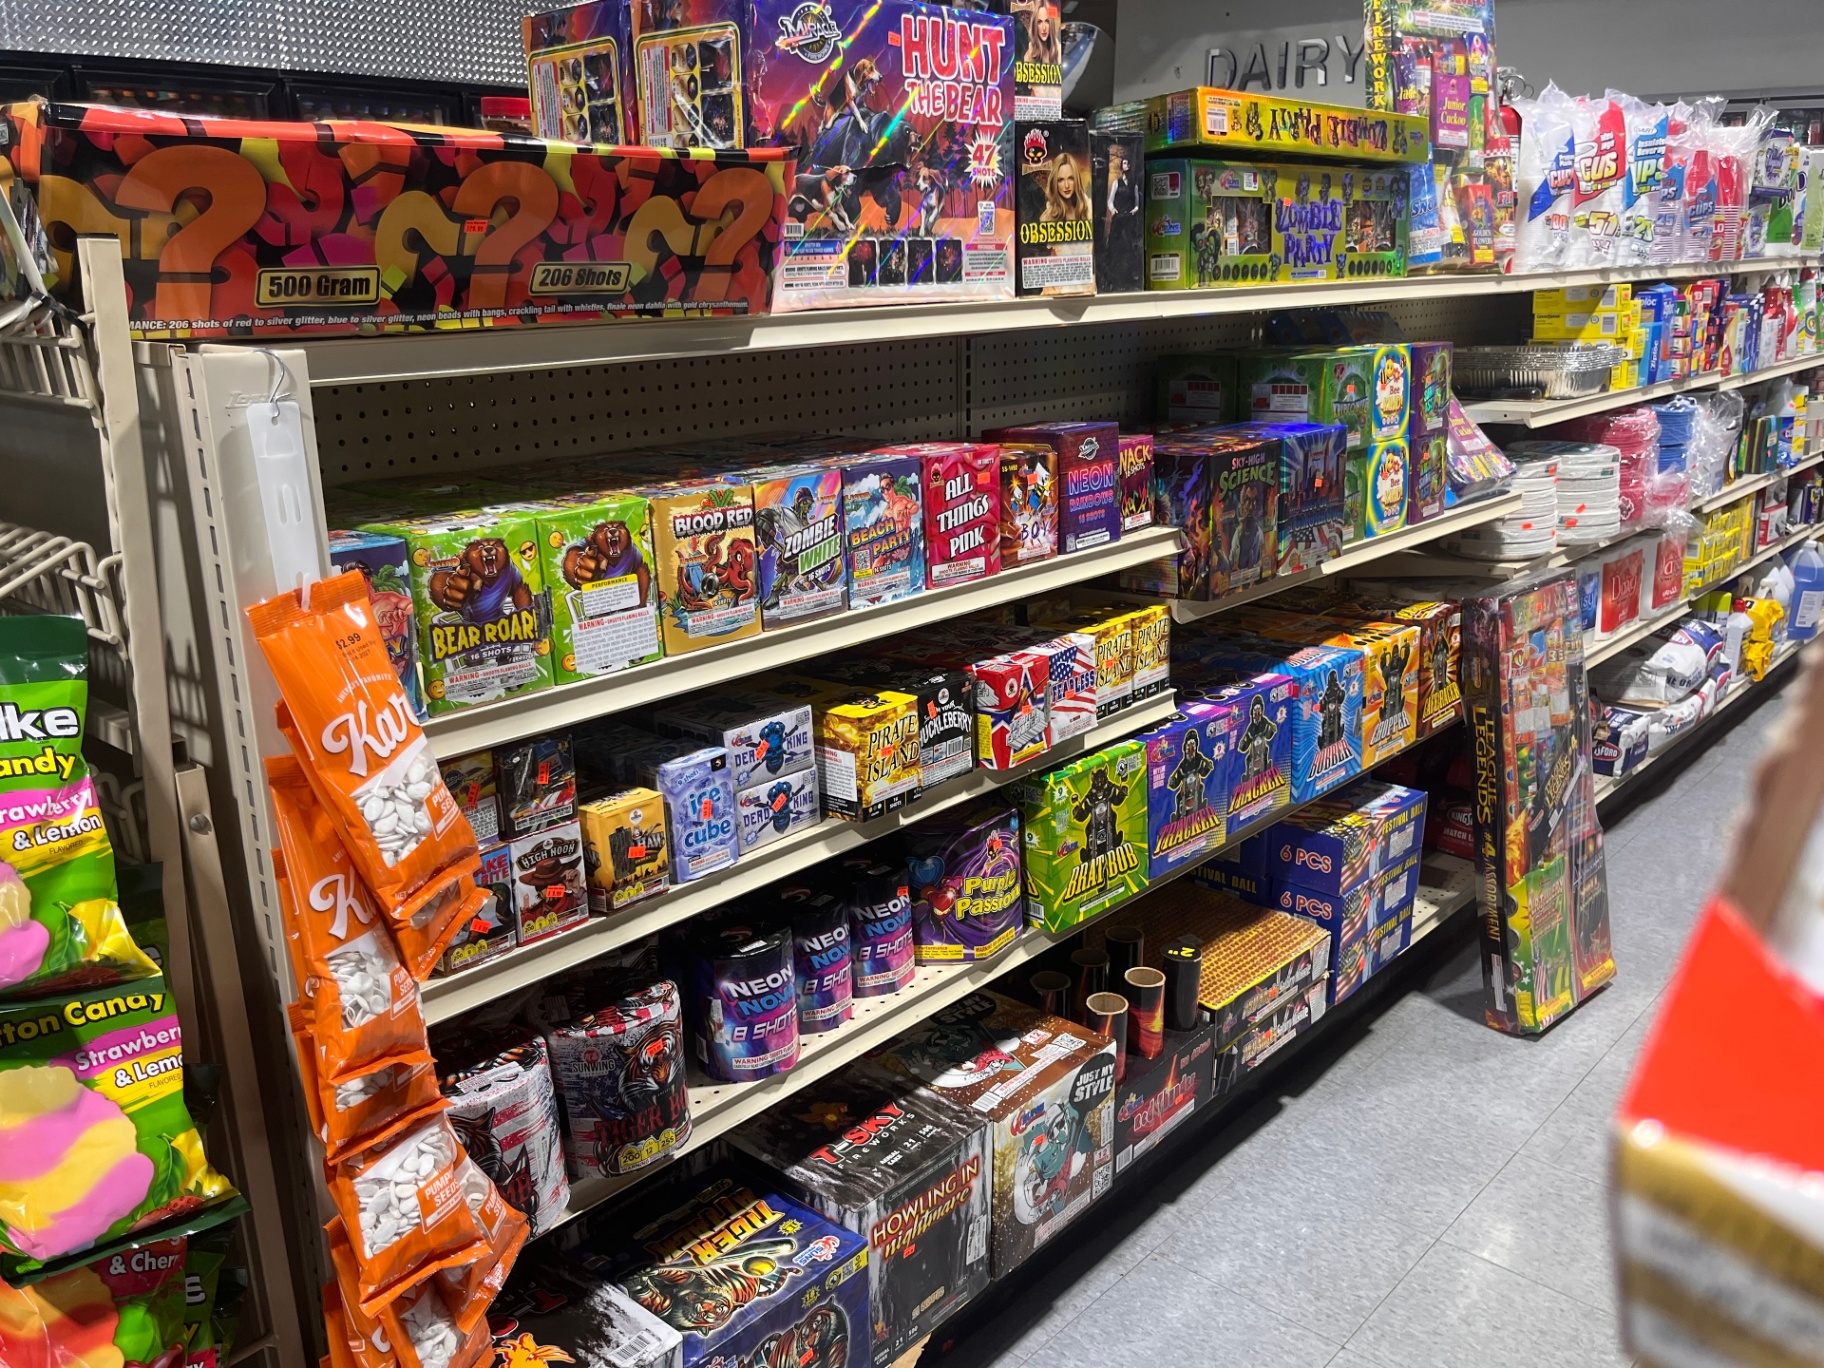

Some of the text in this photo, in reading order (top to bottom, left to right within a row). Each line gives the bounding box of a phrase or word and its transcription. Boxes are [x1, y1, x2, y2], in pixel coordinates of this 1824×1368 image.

[783, 19, 838, 38] MIRACLE
[902, 14, 1005, 84] HUNT
[1371, 0, 1387, 111] FIREWORK
[1015, 61, 1062, 85] BSESSION
[1207, 35, 1364, 91] DAIRY
[905, 79, 1003, 125] THE BEAR
[1443, 97, 1466, 112] Junior
[1441, 111, 1467, 125] Cuckoo
[972, 143, 996, 167] 47
[972, 167, 996, 178] SHOTS
[1275, 199, 1343, 234] ZOMBIE
[1689, 202, 1713, 218] CUPS
[1021, 220, 1093, 245] OBSESSION
[1023, 257, 1047, 266] WARNING
[1283, 233, 1336, 268] PARTY
[269, 275, 371, 298] 500 Gram
[538, 267, 622, 288] 206 Shots
[169, 319, 189, 330] 206
[191, 318, 221, 329] shots
[222, 318, 234, 328] of
[235, 318, 252, 327] red
[254, 317, 265, 327] to
[266, 316, 293, 327] silver
[295, 315, 326, 327] glitter,
[328, 315, 348, 325] blue
[350, 315, 360, 324] to
[361, 313, 387, 324] silver
[388, 313, 415, 324] glitter,
[417, 312, 436, 322] neon
[438, 309, 462, 320] beads
[463, 309, 480, 318] with
[482, 307, 508, 319] bangs,
[509, 305, 543, 316] crackling
[544, 305, 556, 313] tail
[558, 304, 573, 313] with
[607, 302, 626, 310] finale
[1650, 340, 1659, 370] Ziploc
[1389, 386, 1401, 394] Bee
[1231, 452, 1266, 471] SKY-HIGH
[945, 473, 973, 502] ALL
[1068, 463, 1114, 496] NEON
[1218, 461, 1277, 502] SCIENCE
[1390, 479, 1401, 488] Bee
[937, 495, 990, 533] THINGS
[1069, 490, 1115, 512] RAINBOWS
[675, 507, 753, 537] BLOOD RED
[850, 517, 896, 547] BEACH
[784, 515, 836, 559] ZOMBIE
[873, 530, 911, 557] PARTY
[950, 525, 985, 559] PINK
[799, 534, 841, 574] WHITE
[947, 561, 970, 569] WARNING
[592, 577, 628, 589] PERFORMANCE
[784, 597, 804, 606] WARNING
[578, 618, 605, 631] WARNING
[692, 615, 714, 624] WARNING
[335, 632, 361, 650] $2.99
[432, 608, 539, 660] BEAR ROAR!
[1137, 617, 1170, 651] PIRATE
[471, 646, 512, 661] 16 SHOTS
[1096, 632, 1131, 667] PIRATE
[1134, 639, 1170, 672] ISLAND
[361, 673, 393, 684] FAVORITE
[449, 672, 480, 684] WARNING
[1052, 670, 1096, 703] FEARLESS
[942, 700, 955, 712] YOUR
[786, 731, 808, 750] KING
[866, 714, 917, 760] PIRATE
[1370, 711, 1411, 746] CHOPPER
[866, 741, 920, 784] ISLAND
[1307, 739, 1354, 781] BOBBER
[1472, 706, 1491, 825] LEGENDS
[1485, 719, 1497, 804] LEAGUE
[682, 769, 699, 784] shots
[689, 786, 721, 815] ice
[793, 790, 814, 810] KING
[1227, 766, 1287, 816] TRACKER
[742, 807, 770, 829] DEAD
[1153, 805, 1221, 858] TRACKER
[1381, 807, 1409, 835] FESTIVAL
[1410, 801, 1423, 819] BALL
[13, 815, 103, 851] & Lemon
[685, 818, 731, 849] cube
[1443, 827, 1464, 840] MATCH
[48, 840, 84, 855] FLAVORED
[522, 842, 576, 869] HIGH NOON
[1280, 844, 1332, 874] 6 PCS
[481, 867, 510, 885] BITE
[1064, 844, 1139, 901] BRAT BOB
[1404, 854, 1418, 872] BALL
[964, 869, 1017, 896] Purple
[1231, 876, 1257, 894] BALL
[855, 894, 910, 921] NEON
[955, 883, 1021, 920] Passion
[1280, 891, 1332, 920] 6 PCS
[1399, 903, 1412, 923] BALL
[1483, 863, 1500, 942] ASSORTMENT
[864, 908, 911, 937] NOVA
[858, 929, 913, 960] 8 SHOTS
[727, 965, 794, 998] NEON
[804, 979, 818, 995] 8
[858, 973, 892, 983] WARNING
[732, 1005, 798, 1042] 8 SHOTS
[804, 1006, 835, 1017] WARNING
[572, 1058, 615, 1075] SUNWING
[734, 1055, 770, 1065] WARNING
[115, 1068, 134, 1089] &
[1076, 1063, 1115, 1087] JUST MY
[1074, 1076, 1113, 1103] STYLE
[594, 1110, 664, 1147] TIGER
[810, 1101, 904, 1164] T-SKY
[838, 1112, 917, 1170] FIREWORKS
[622, 1146, 653, 1164] 200 12
[903, 1138, 916, 1148] 21
[880, 1150, 900, 1166] AERIAL
[873, 1171, 959, 1247] HOWLING
[961, 1157, 980, 1184] IN
[698, 1200, 786, 1267] TIGER
[884, 1186, 971, 1260] nightmare
[109, 1255, 127, 1275] &
[798, 1244, 824, 1266] SUNS
